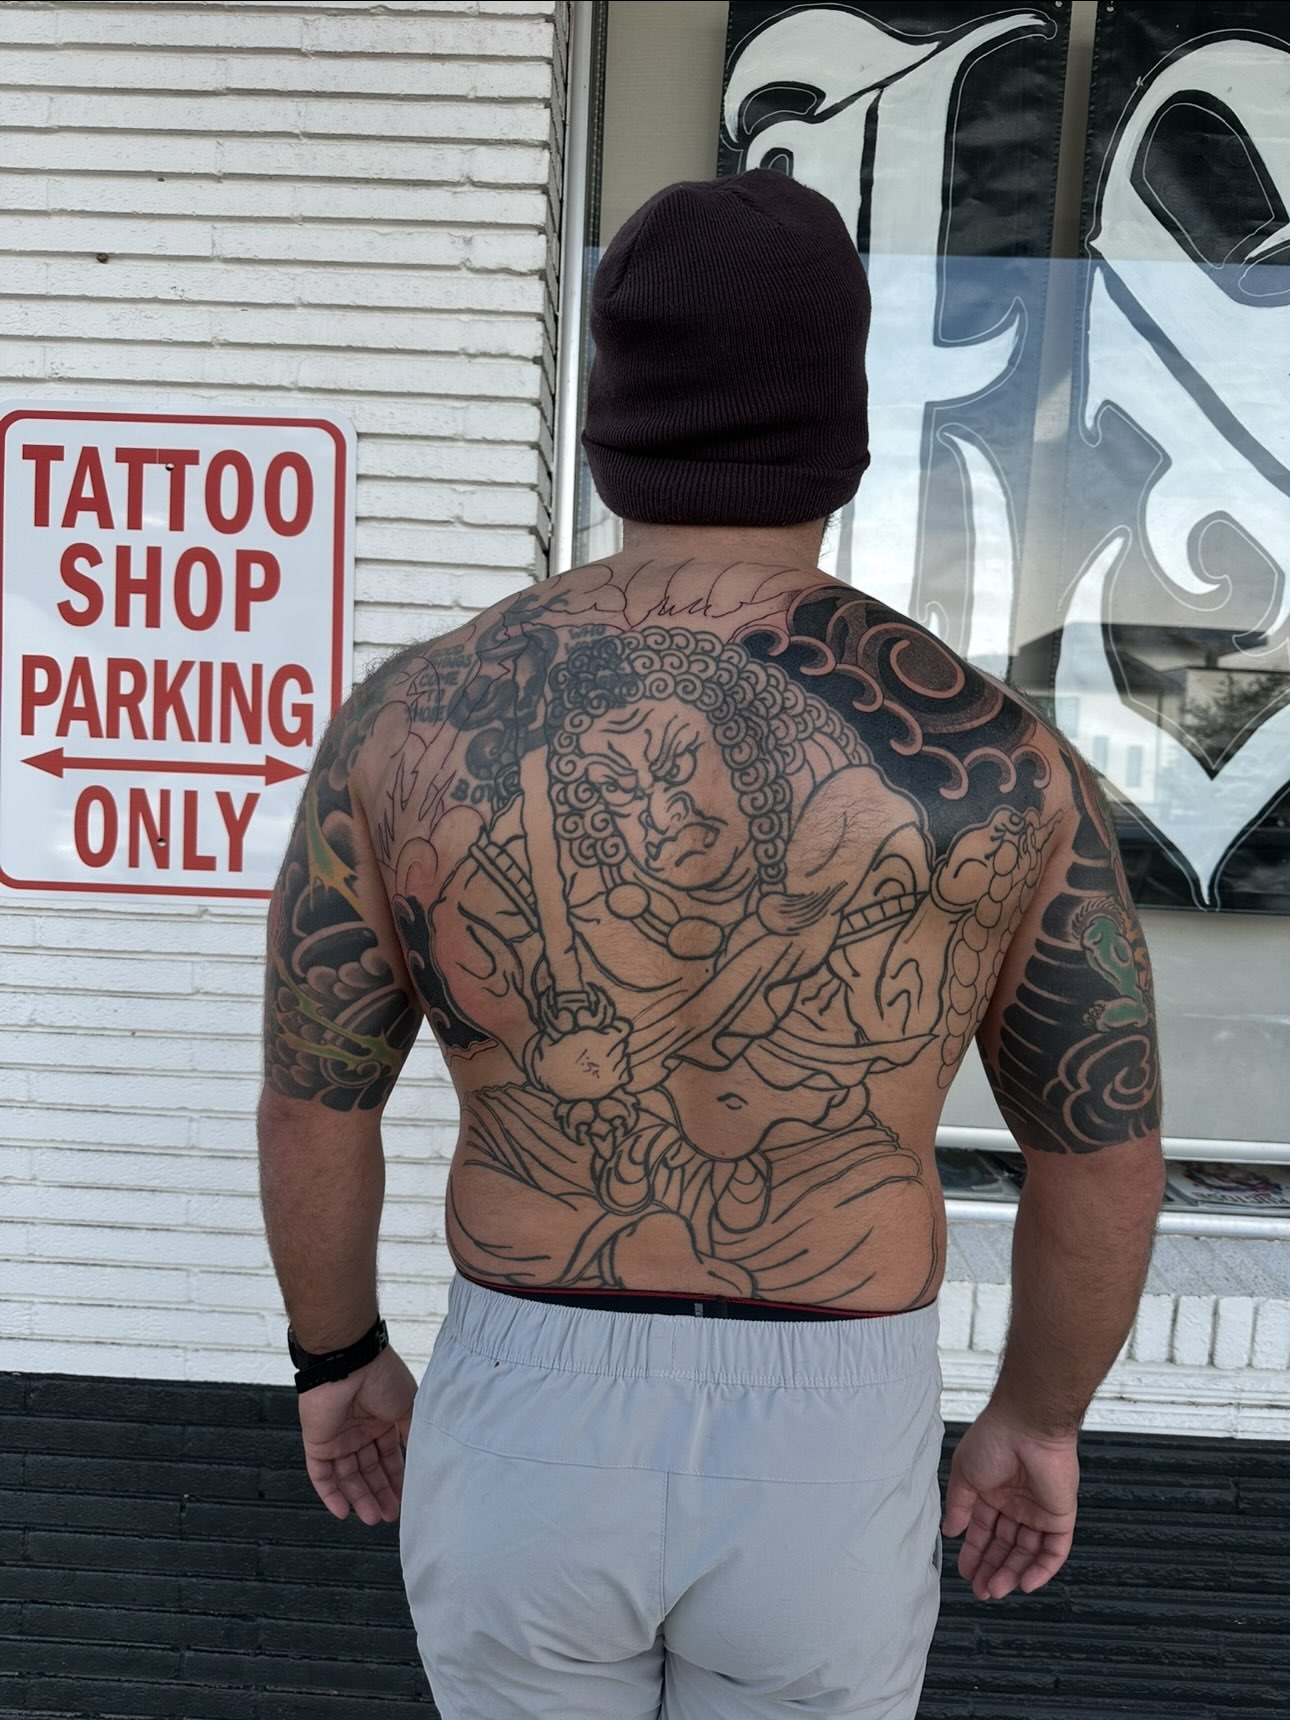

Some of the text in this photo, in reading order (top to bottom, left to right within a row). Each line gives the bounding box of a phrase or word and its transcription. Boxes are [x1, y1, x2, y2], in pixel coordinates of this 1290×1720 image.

[22, 444, 314, 537] TATTOO
[57, 542, 281, 632] SHOP
[20, 654, 314, 747] PARKING
[74, 785, 261, 872] ONLY
